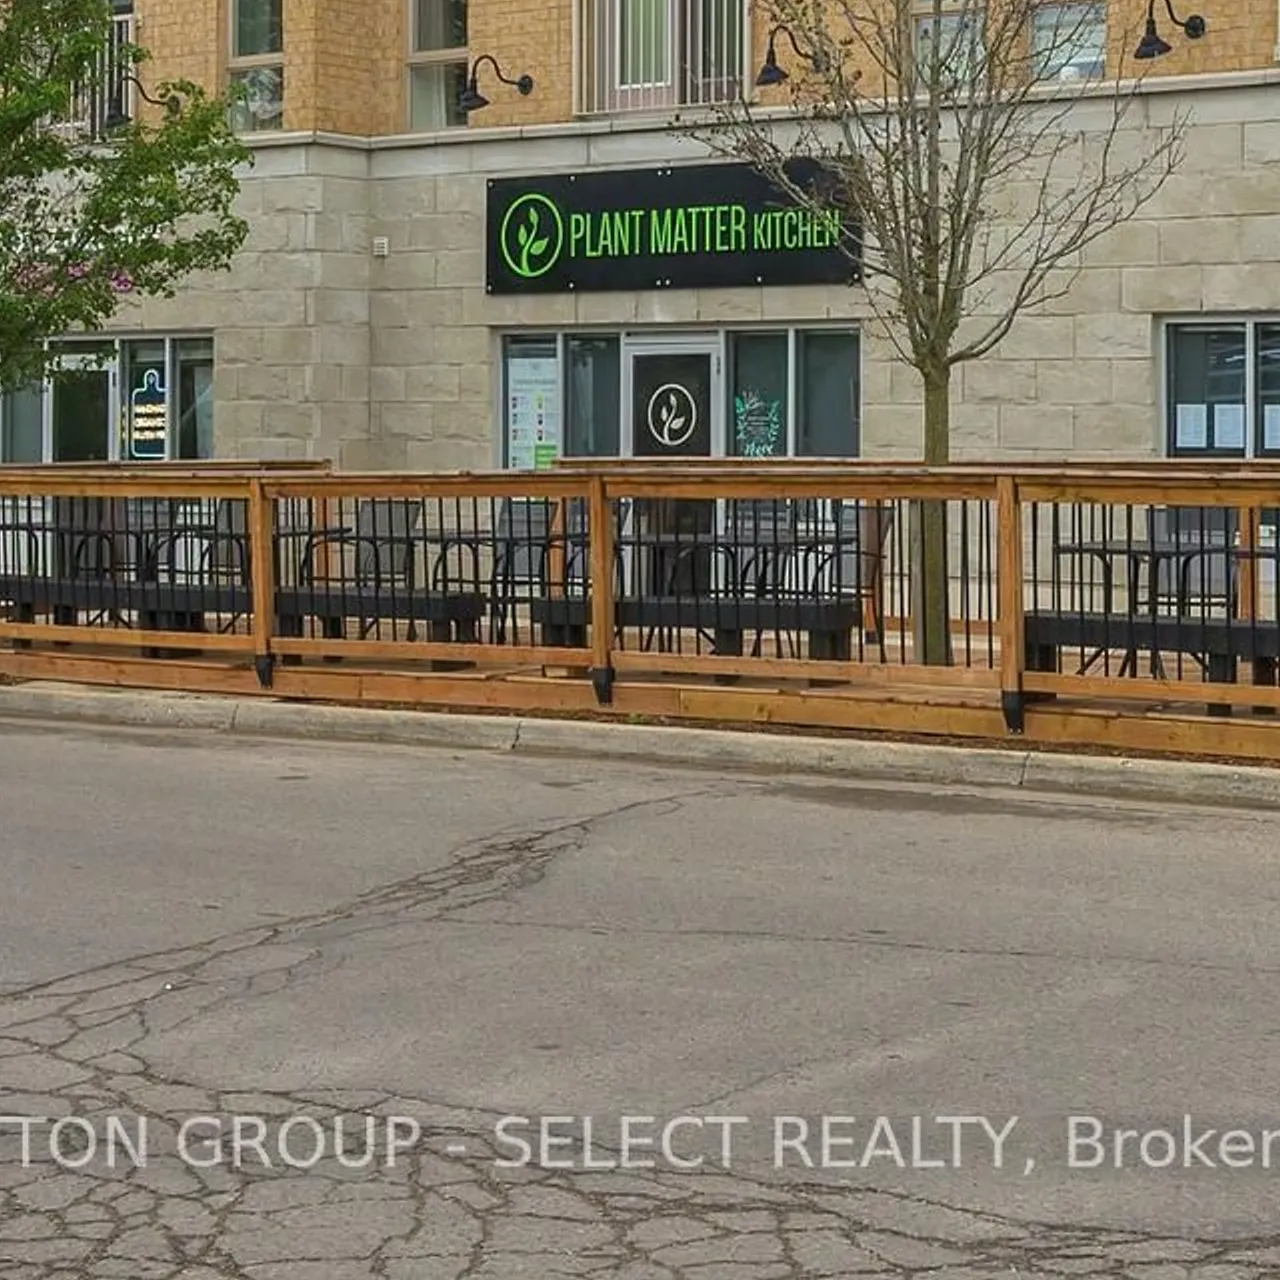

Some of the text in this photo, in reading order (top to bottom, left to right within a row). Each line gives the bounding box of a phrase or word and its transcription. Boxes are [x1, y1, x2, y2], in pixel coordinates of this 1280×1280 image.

[570, 205, 842, 258] PLANT MATTER KITCHEN
